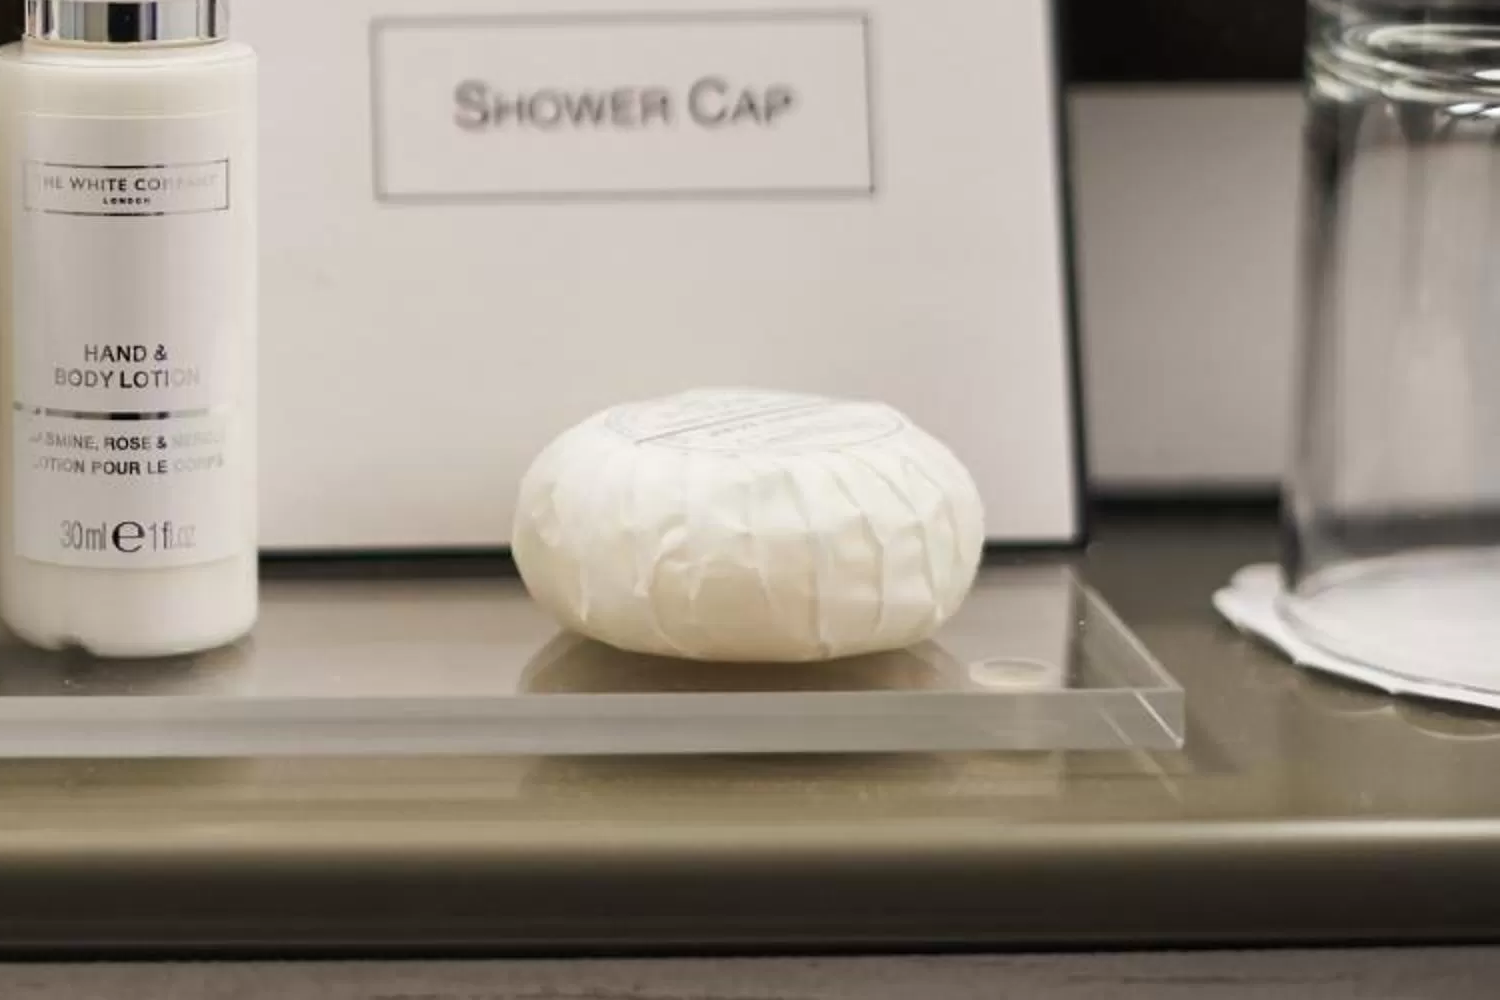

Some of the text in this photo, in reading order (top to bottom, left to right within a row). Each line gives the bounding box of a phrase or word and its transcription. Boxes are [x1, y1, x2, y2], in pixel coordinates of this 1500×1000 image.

[453, 75, 797, 130] SHOWER CAP
[68, 177, 128, 192] WHITE
[83, 344, 169, 362] HAND &
[54, 368, 200, 389] BODY LOTION
[103, 435, 152, 451] ROSE
[156, 435, 168, 449] &
[91, 459, 141, 476] POUR
[147, 459, 169, 474] LE
